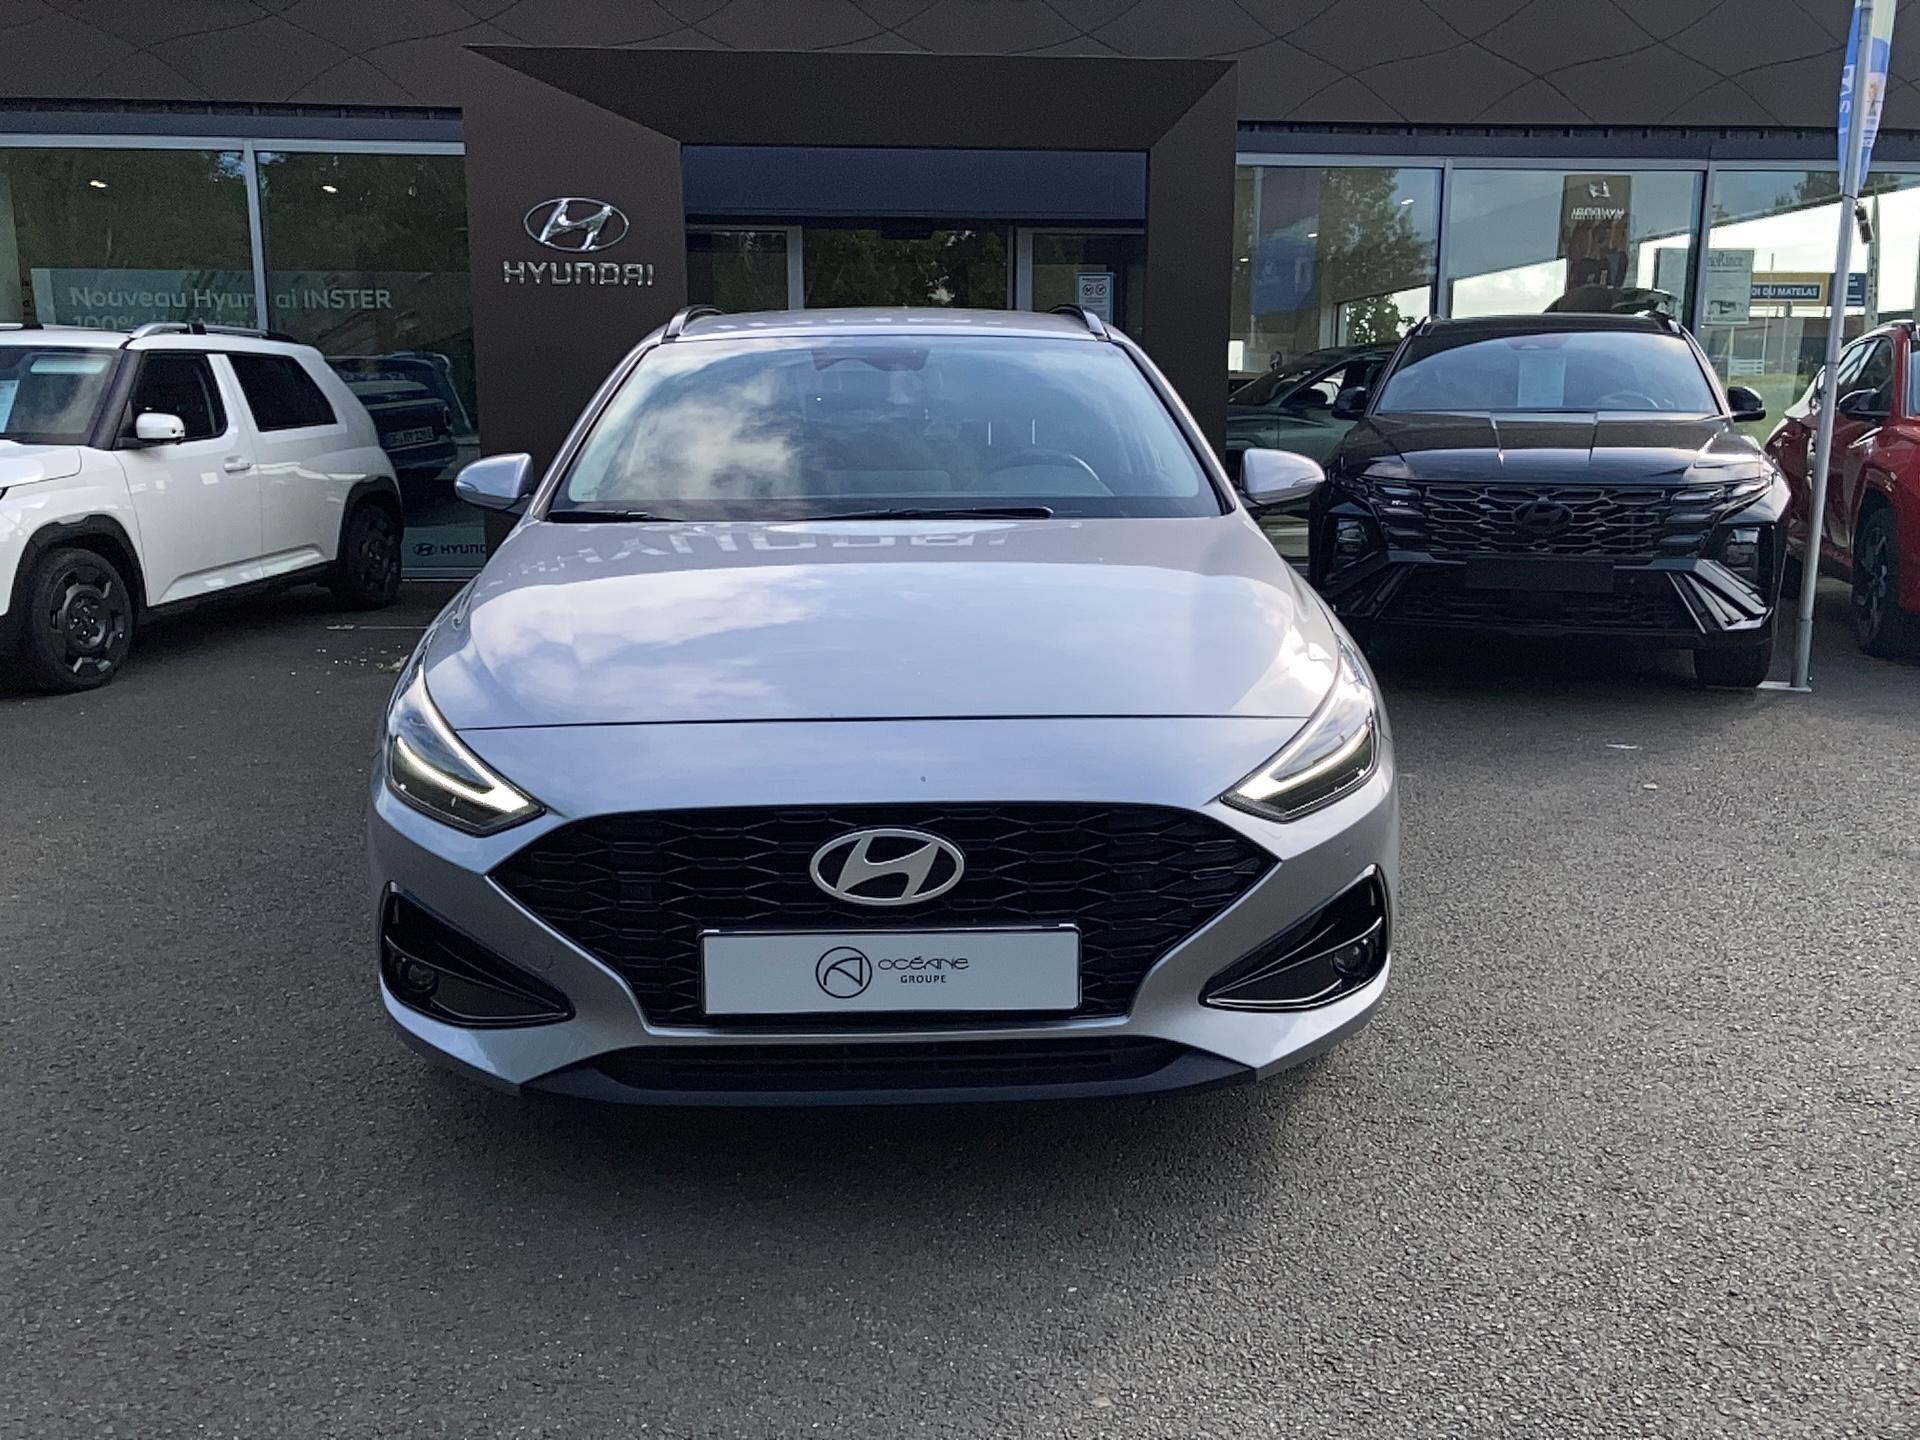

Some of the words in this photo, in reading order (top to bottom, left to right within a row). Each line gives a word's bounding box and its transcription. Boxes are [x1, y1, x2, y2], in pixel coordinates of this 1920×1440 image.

[502, 260, 655, 287] HYUNDAI
[1777, 287, 1818, 297] MATELAS
[69, 286, 187, 309] Nouveau
[194, 287, 298, 312] Hyunai
[303, 288, 393, 310] INSTER
[440, 543, 487, 555] HYUND
[899, 974, 947, 984] GROUPE
